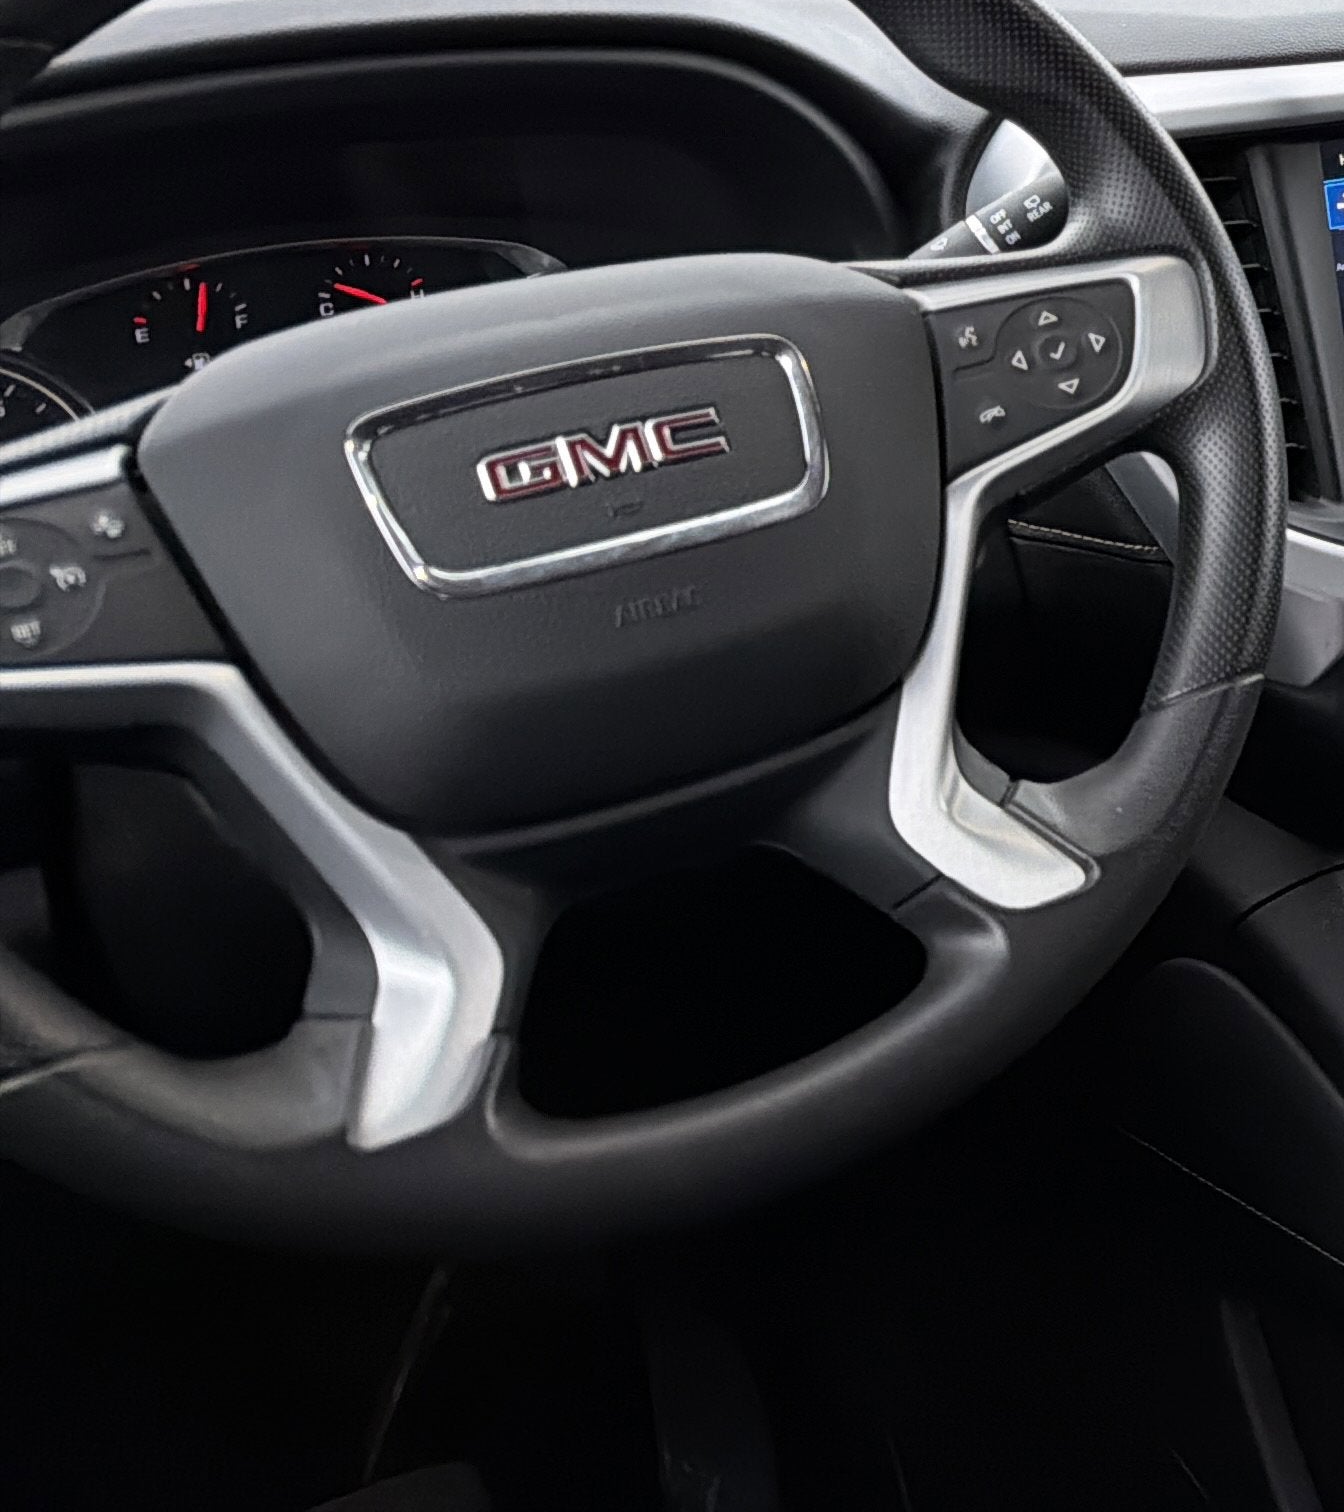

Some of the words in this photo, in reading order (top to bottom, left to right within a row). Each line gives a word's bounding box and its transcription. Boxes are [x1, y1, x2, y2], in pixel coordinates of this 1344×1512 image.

[1026, 201, 1053, 223] REAR
[319, 302, 335, 317] C
[235, 314, 248, 329] F
[134, 328, 150, 343] E
[476, 406, 731, 502] GMC
